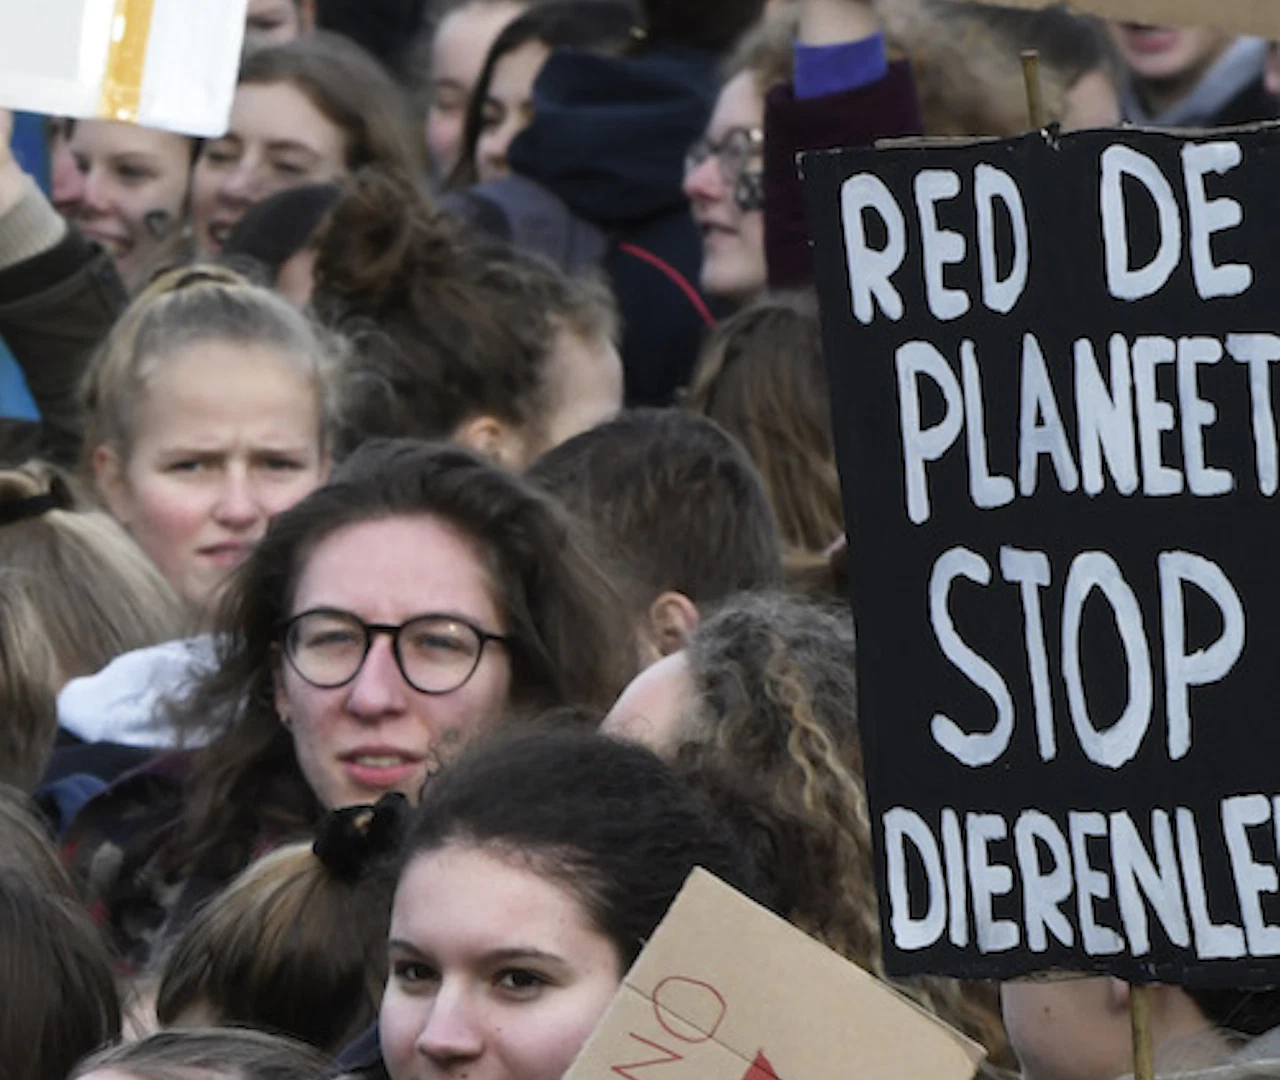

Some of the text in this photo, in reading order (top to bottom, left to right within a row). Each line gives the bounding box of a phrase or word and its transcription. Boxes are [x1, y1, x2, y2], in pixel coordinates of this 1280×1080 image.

[839, 141, 1253, 324] RED DE
[895, 332, 1280, 524] PLANEET
[930, 546, 1246, 769] STOP
[883, 795, 1280, 960] DIERENLE
